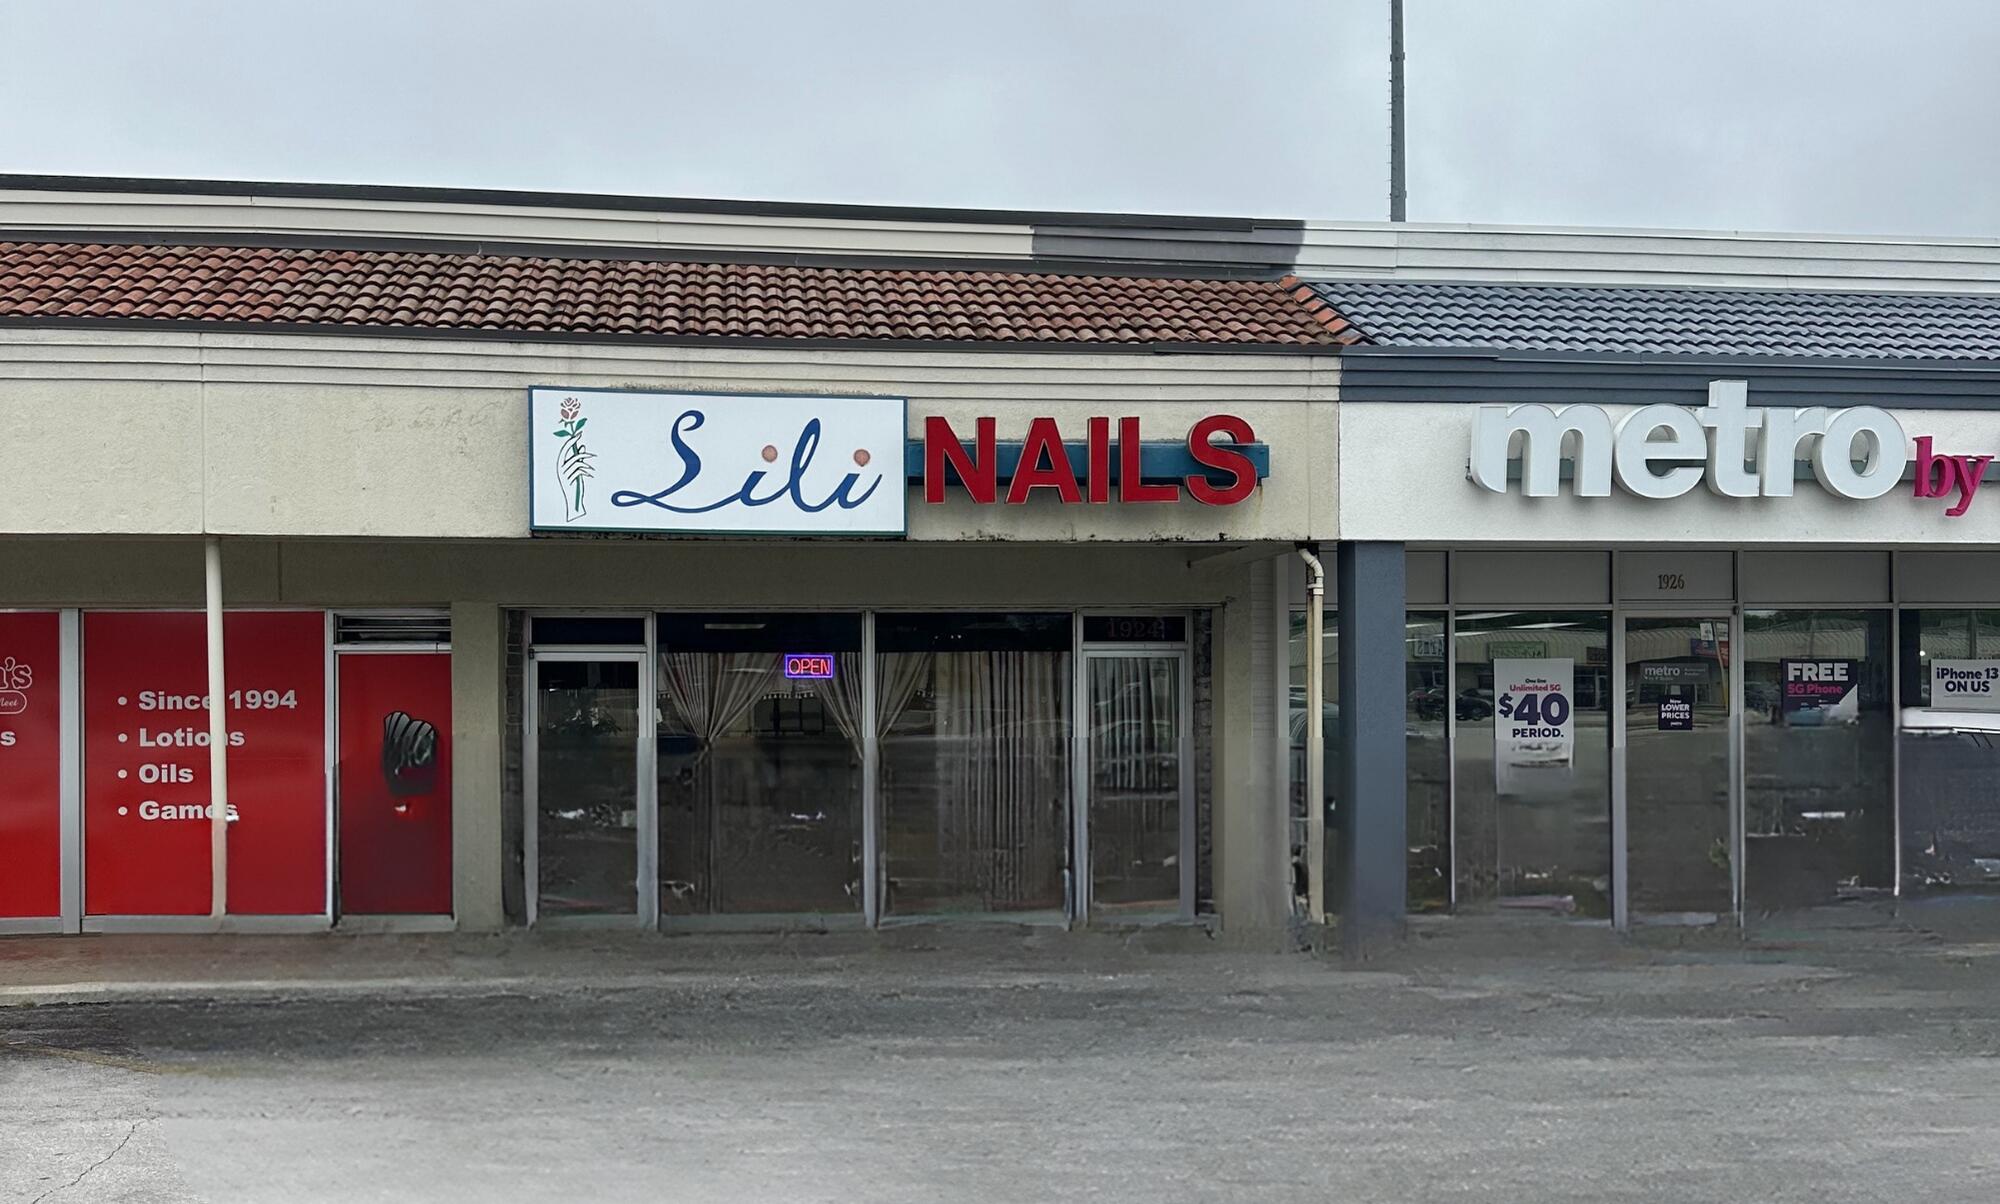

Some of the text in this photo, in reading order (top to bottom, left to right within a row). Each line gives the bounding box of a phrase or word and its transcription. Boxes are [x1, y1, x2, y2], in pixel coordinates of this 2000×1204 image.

[1470, 380, 1994, 517] metro by
[612, 410, 883, 513] Lili
[924, 415, 1259, 506] NAILS
[1657, 573, 1686, 590] 1926
[788, 658, 831, 675] OPEN
[1645, 665, 1681, 676] metro
[1787, 662, 1849, 682] FREE
[1936, 667, 1999, 680] iPhone 13
[1509, 684, 1561, 692] Unlimited 5G
[1787, 683, 1843, 694] 5G Phone
[1945, 680, 1990, 693] ON US
[228, 689, 298, 710] 1994
[1499, 693, 1569, 726] $40
[139, 727, 245, 748] Lotios
[1513, 728, 1564, 738] PERIOD.
[138, 763, 194, 784] Oils
